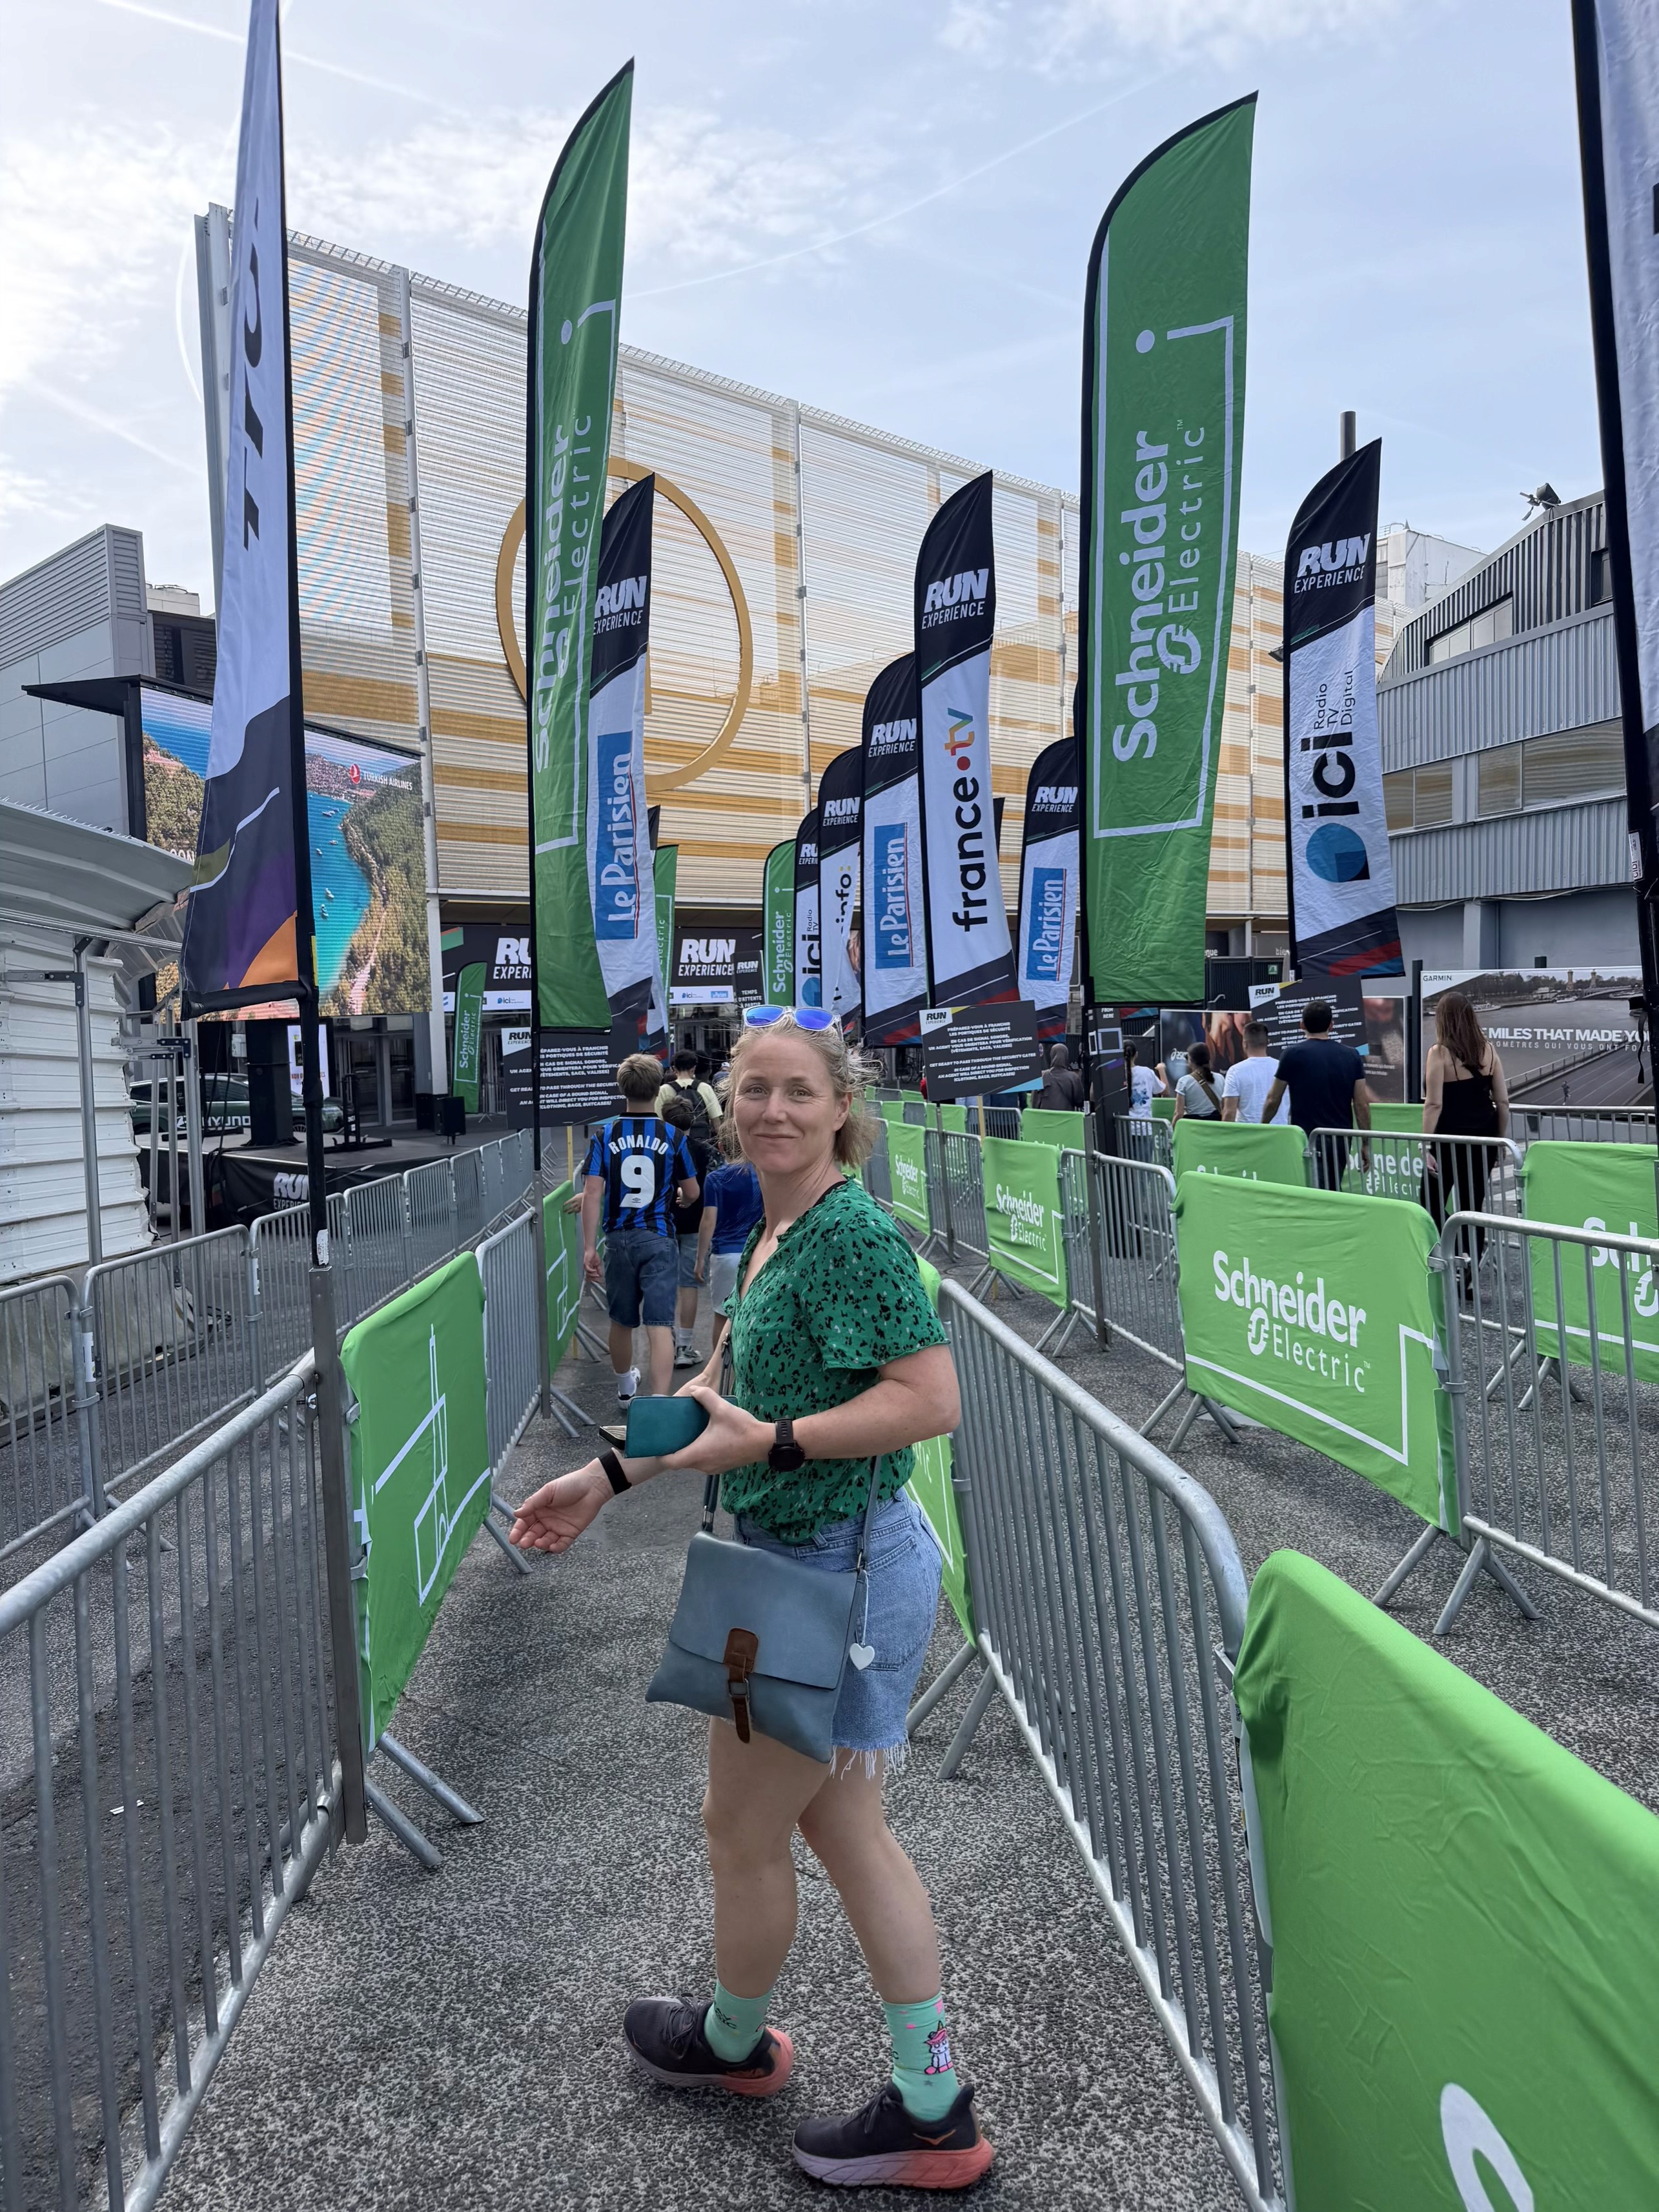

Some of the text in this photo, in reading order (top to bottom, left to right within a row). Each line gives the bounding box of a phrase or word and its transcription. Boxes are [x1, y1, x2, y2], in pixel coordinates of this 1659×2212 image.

[563, 415, 591, 616] Electric
[1168, 427, 1205, 613] Electric
[1297, 532, 1371, 578] RUN
[924, 568, 989, 614] RUN
[1294, 565, 1365, 594] EXPERIENCE
[594, 576, 647, 618] RUN
[1112, 431, 1168, 762] Schneider
[593, 609, 642, 636] EXPERIENCE
[921, 601, 986, 629] EXPERIENCE
[1314, 683, 1328, 730] Radio
[1340, 670, 1356, 725] Digital
[1327, 707, 1339, 728] TV
[870, 718, 917, 746] RUN
[868, 741, 915, 758] EXPERIENCE
[363, 771, 412, 791] TURKISH AIRLINES
[1300, 731, 1360, 819] ici
[824, 797, 860, 818] RUN
[1032, 803, 1075, 813] EXPERIENCE
[1035, 786, 1078, 804] RUN
[822, 814, 858, 827] EXPERIENCE
[600, 752, 636, 921] Le Parisien
[800, 843, 818, 858] RU
[880, 837, 910, 956] Le Parisien
[813, 922, 819, 932] TV
[1032, 879, 1063, 972] Le Parisien
[495, 938, 531, 965] RU
[680, 939, 736, 963] RUN
[737, 960, 758, 969] RUN
[772, 911, 786, 993] Schneider
[801, 934, 821, 974] ici
[678, 964, 733, 977] EXPERIENCE
[1255, 987, 1274, 995] RUN
[926, 1011, 946, 1020] RUN
[460, 1010, 472, 1068] Schneider
[669, 1033, 675, 1043] 2
[1488, 1027, 1532, 1040] MILES
[1532, 1028, 1574, 1040] THAT
[1575, 1029, 1622, 1042] MADE
[202, 1115, 251, 1126] HYUND
[608, 1134, 669, 1155] RONALDO
[619, 1155, 655, 1208] 9
[895, 1154, 918, 1183] Schneider
[996, 1183, 1044, 1228] Schneider
[1019, 1225, 1046, 1252] Electric
[1213, 1250, 1367, 1348] Schneider
[1273, 1323, 1365, 1393] Electric
